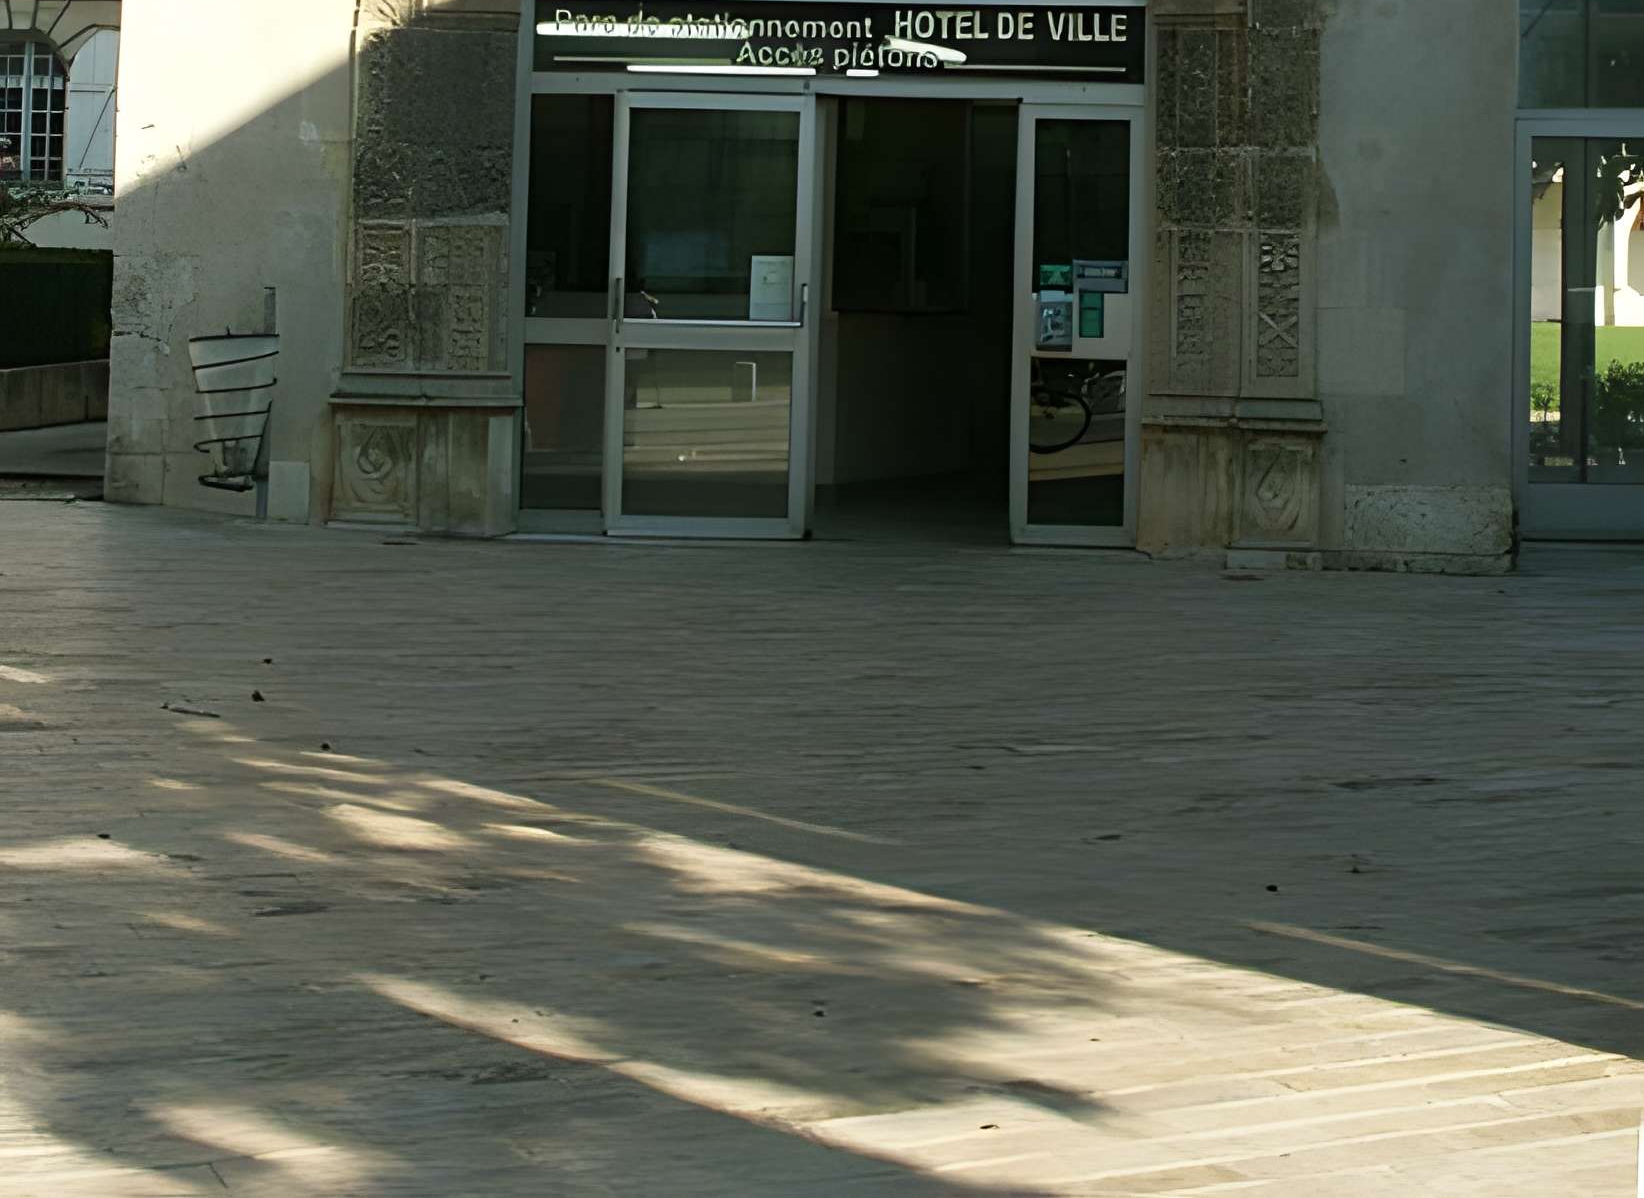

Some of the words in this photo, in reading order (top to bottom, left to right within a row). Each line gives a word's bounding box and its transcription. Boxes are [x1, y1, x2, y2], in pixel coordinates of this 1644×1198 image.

[894, 10, 989, 40] HOTEL
[998, 12, 1035, 40] DE
[1047, 11, 1128, 42] VILLE
